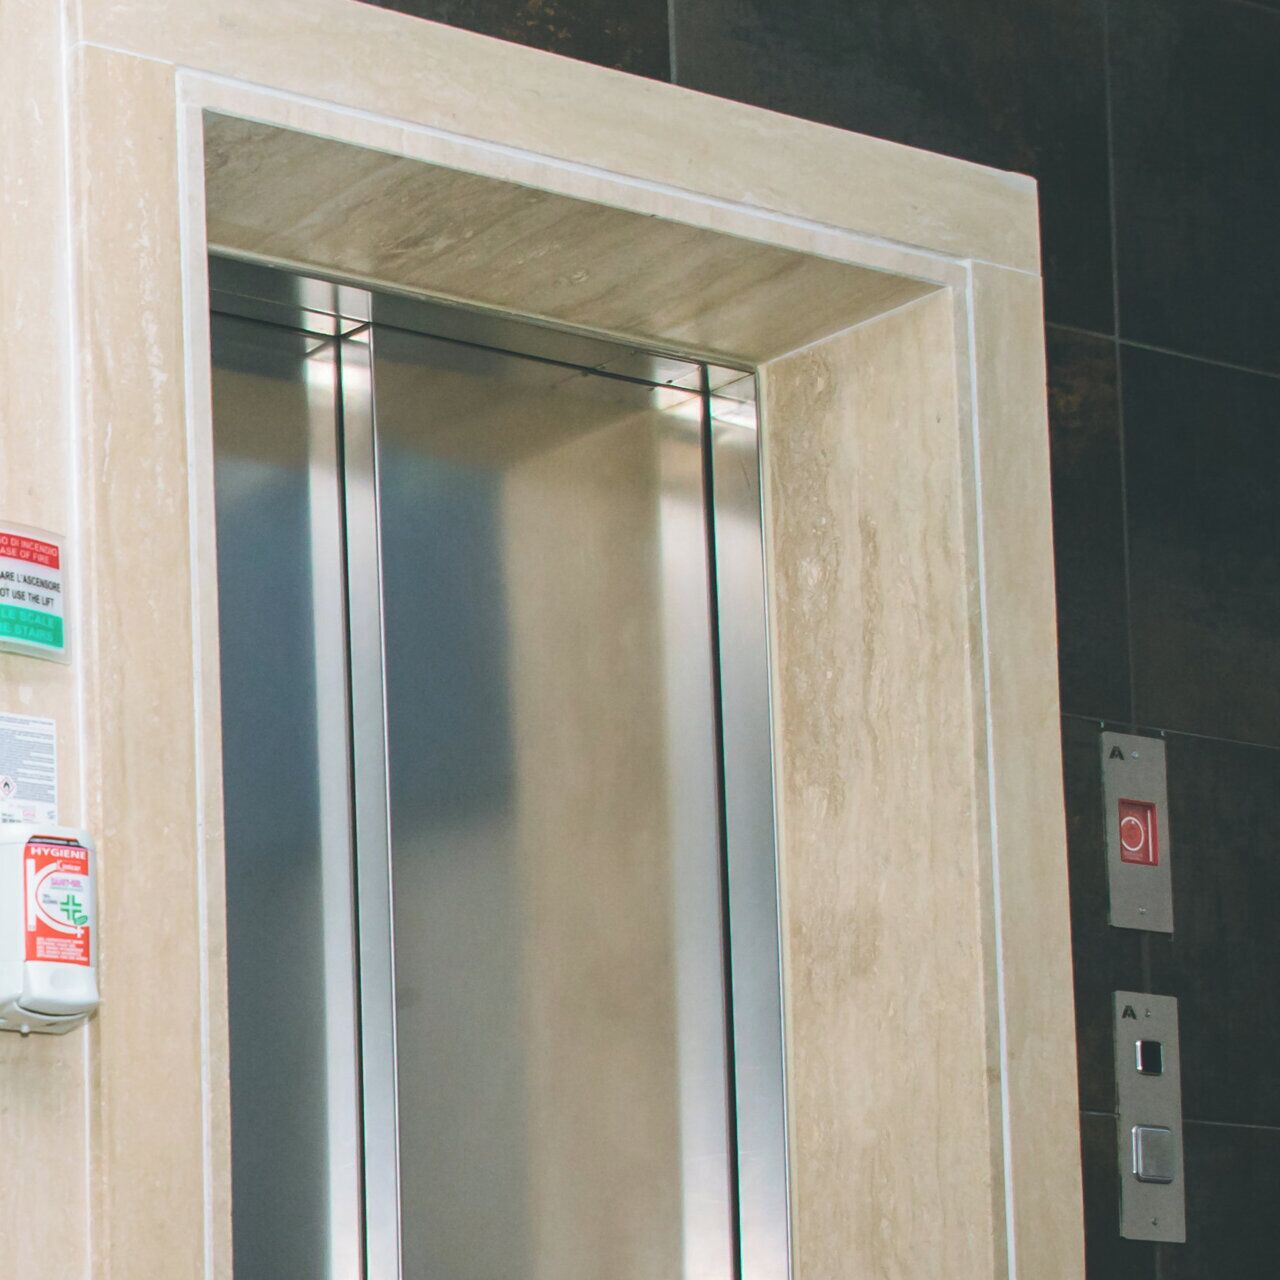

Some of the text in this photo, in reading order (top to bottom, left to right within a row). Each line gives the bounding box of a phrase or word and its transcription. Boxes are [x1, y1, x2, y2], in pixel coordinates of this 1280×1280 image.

[10, 536, 21, 547] DI
[21, 538, 58, 557] INCENDIO
[19, 549, 31, 560] OF
[32, 552, 51, 565] FIRE
[16, 573, 61, 593] L'ASCENSORE
[11, 590, 26, 601] USE
[28, 592, 40, 604] THE
[41, 596, 55, 607] LIFT
[1, 607, 16, 619] LE
[19, 609, 56, 629] SCALE
[14, 623, 54, 641] STAIRS
[30, 846, 87, 861] HYGIENE
